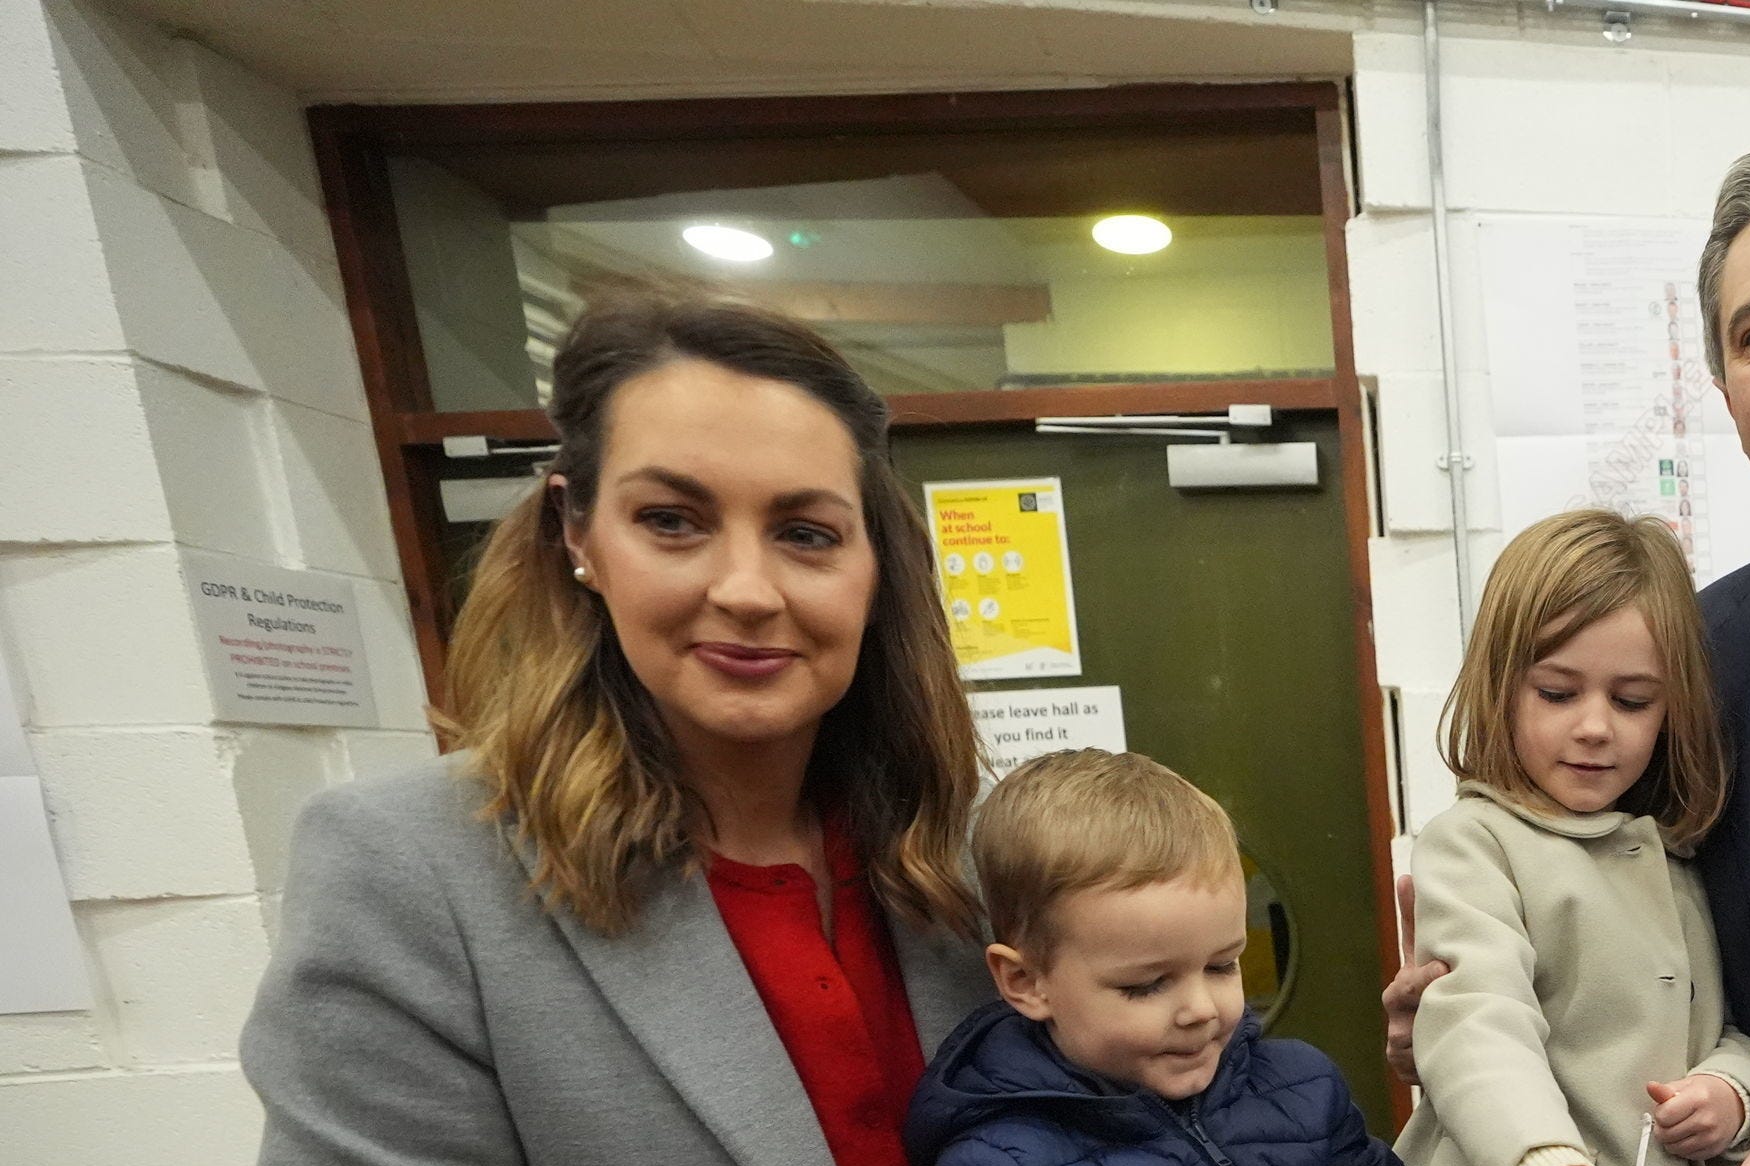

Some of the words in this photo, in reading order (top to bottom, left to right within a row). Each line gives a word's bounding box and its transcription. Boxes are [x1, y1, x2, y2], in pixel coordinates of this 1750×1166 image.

[940, 510, 975, 521] When
[942, 523, 953, 533] at
[956, 520, 992, 533] school
[942, 535, 993, 546] continue
[994, 534, 1011, 545] to:
[201, 581, 237, 600] GDPR
[240, 586, 252, 602] &
[254, 588, 285, 607] Child
[287, 593, 344, 614] Protection
[247, 612, 316, 634] Regulations
[973, 708, 1005, 719] ease
[1008, 705, 1048, 718] leave
[1052, 702, 1078, 716] hall
[1083, 705, 1099, 715] as
[993, 733, 1021, 745] you
[1025, 728, 1054, 741] find
[1058, 728, 1069, 740] it
